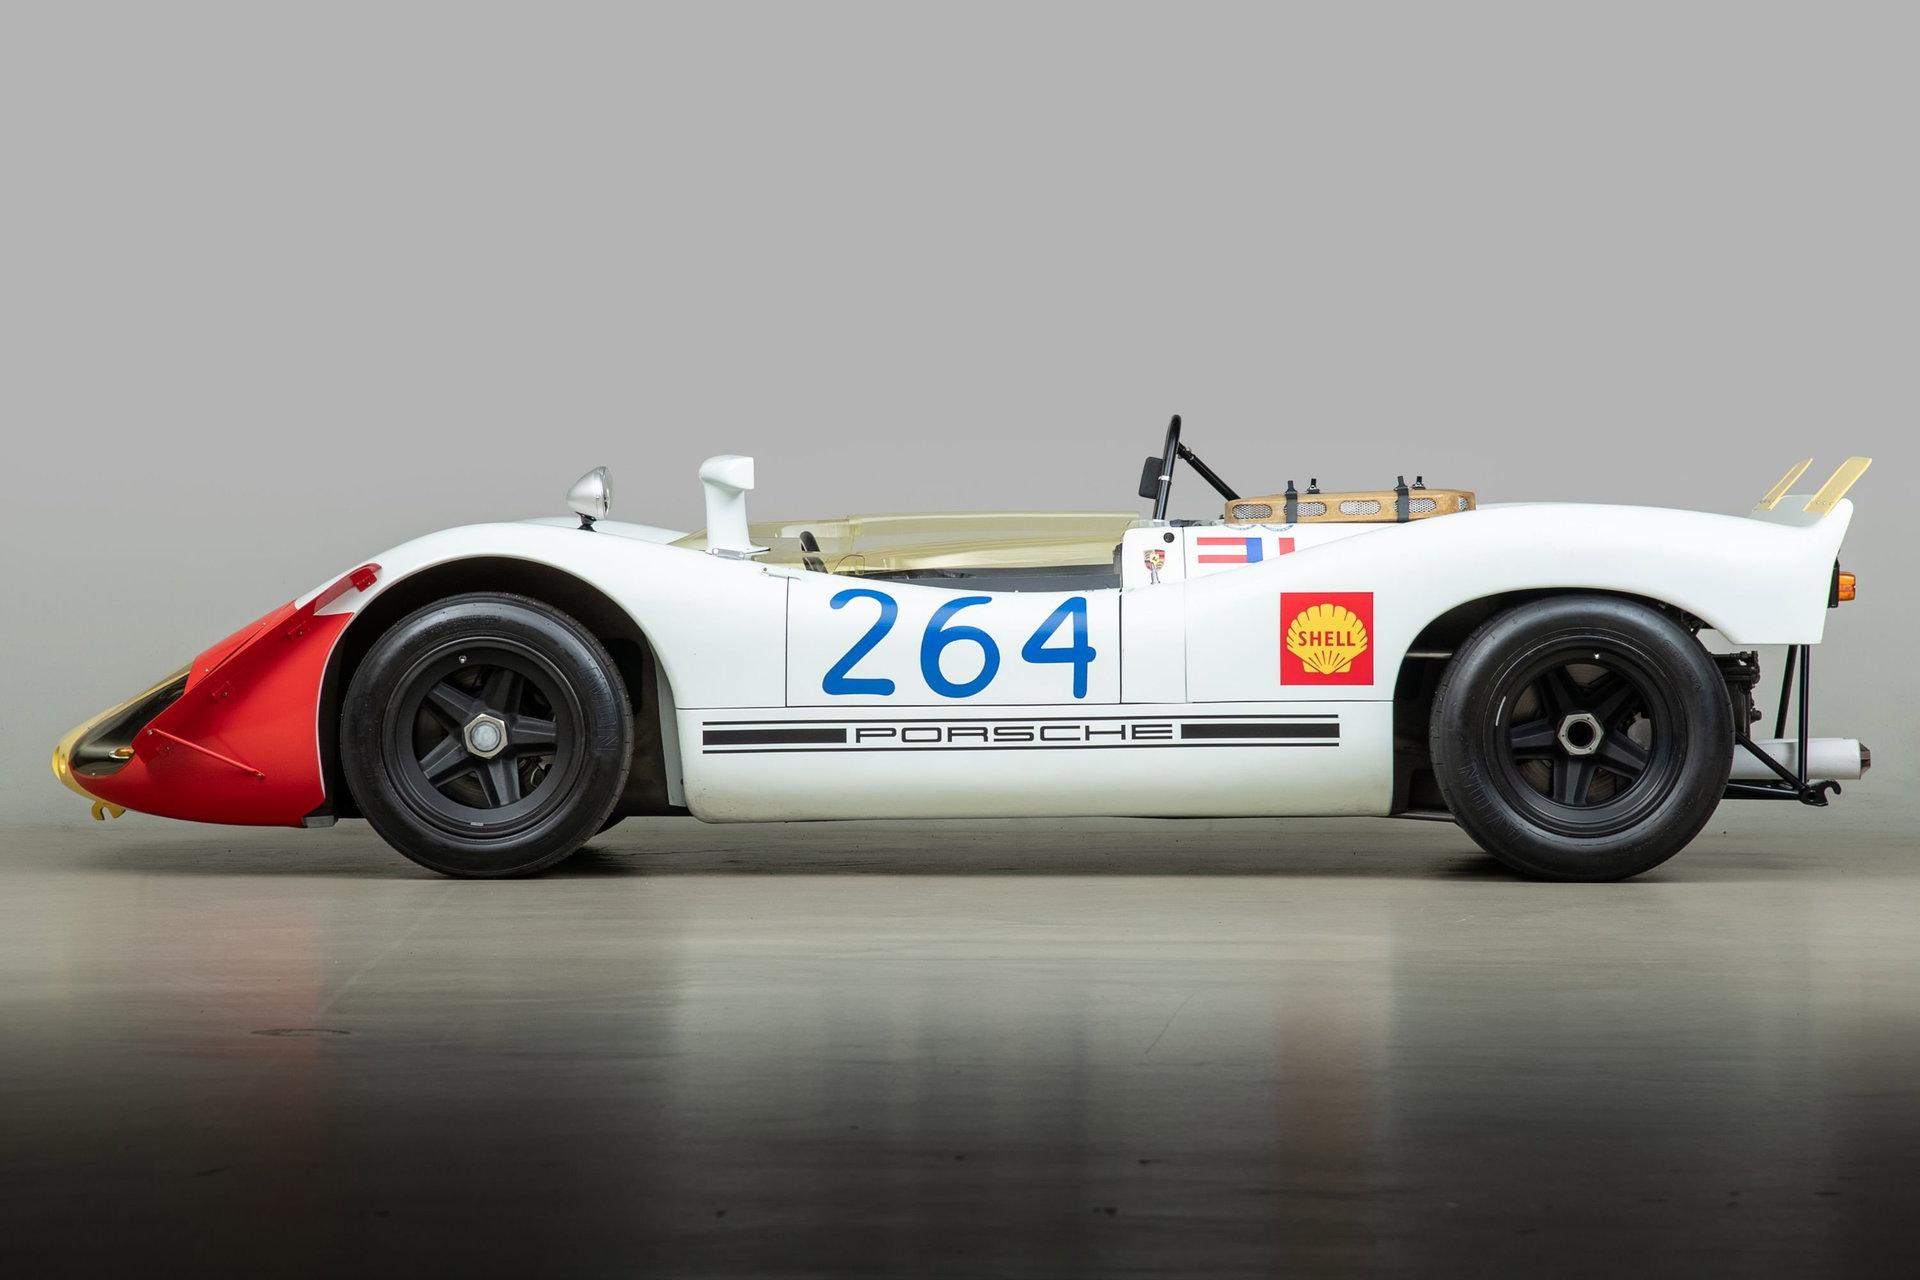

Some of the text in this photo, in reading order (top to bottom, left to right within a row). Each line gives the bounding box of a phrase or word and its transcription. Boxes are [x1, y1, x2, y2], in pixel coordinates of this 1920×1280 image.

[822, 588, 1097, 700] 264
[1298, 630, 1356, 647] SHELL
[855, 723, 1173, 744] PORSCHE
